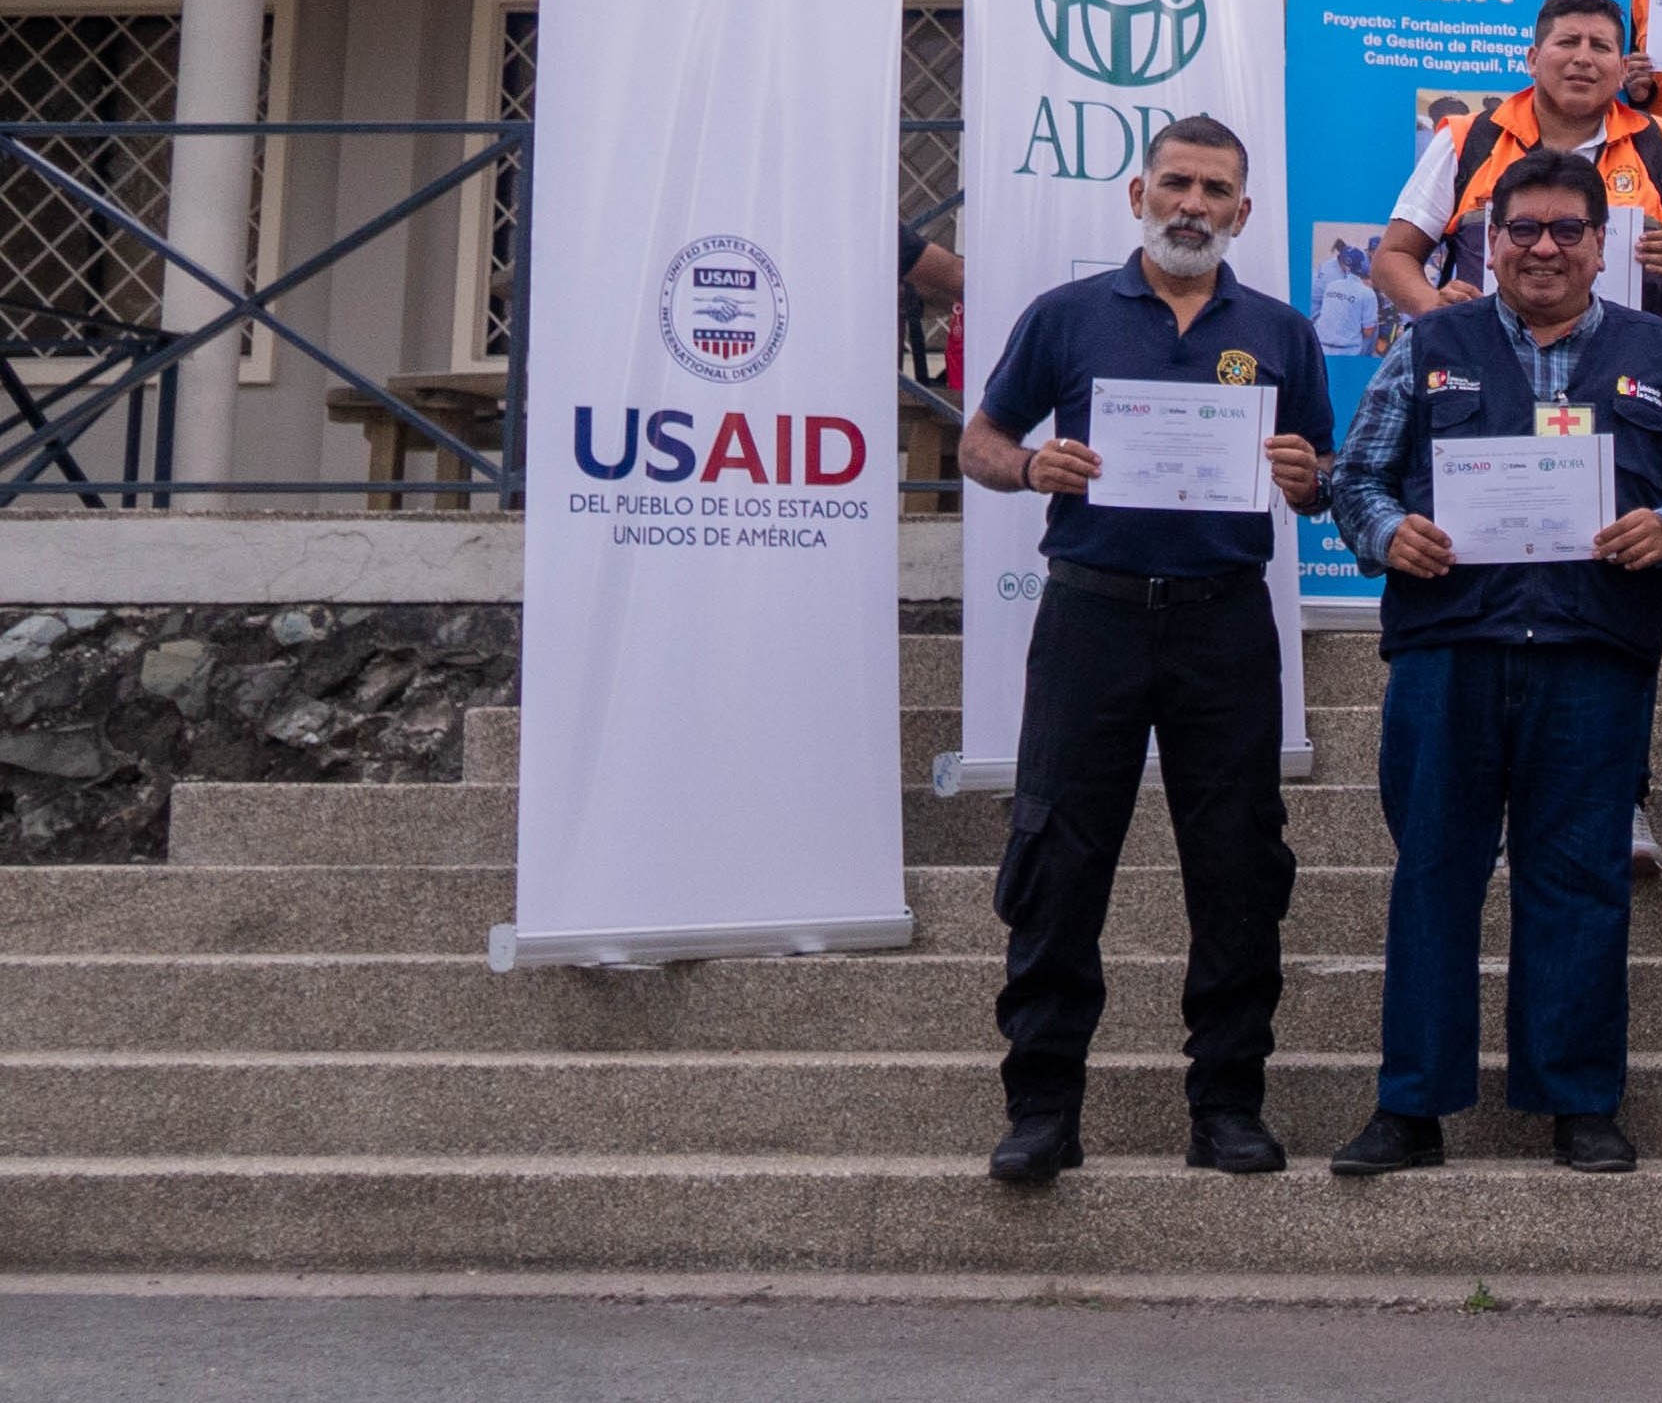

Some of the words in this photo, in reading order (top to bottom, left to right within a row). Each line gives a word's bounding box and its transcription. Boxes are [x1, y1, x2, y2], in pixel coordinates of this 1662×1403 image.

[1323, 12, 1396, 32] Proyecto:
[1401, 17, 1518, 39] Fortalecimiento
[1521, 24, 1533, 38] al
[1363, 32, 1383, 47] de
[1386, 33, 1444, 53] Gestión
[1447, 38, 1467, 53] de
[1364, 50, 1417, 69] Cantón
[1422, 54, 1502, 74] Guayaquil,
[668, 246, 701, 282] UNITED
[703, 239, 746, 252] STATES
[747, 246, 781, 288] AGENCY
[699, 270, 752, 287] USAID
[662, 307, 728, 381] INTERNATIONAL
[732, 313, 786, 381] DEVELOPMENT
[1117, 402, 1151, 414] USAID
[574, 406, 867, 486] USAID
[1458, 461, 1491, 472] USAID
[570, 494, 610, 514] DEL
[616, 495, 694, 516] PUEBLO
[701, 497, 728, 517] DE
[735, 498, 771, 518] LOS
[778, 499, 869, 520] ESTADOS
[614, 525, 696, 546] UNIDOS
[704, 526, 730, 547] DE
[736, 524, 827, 548] AMÉRICA
